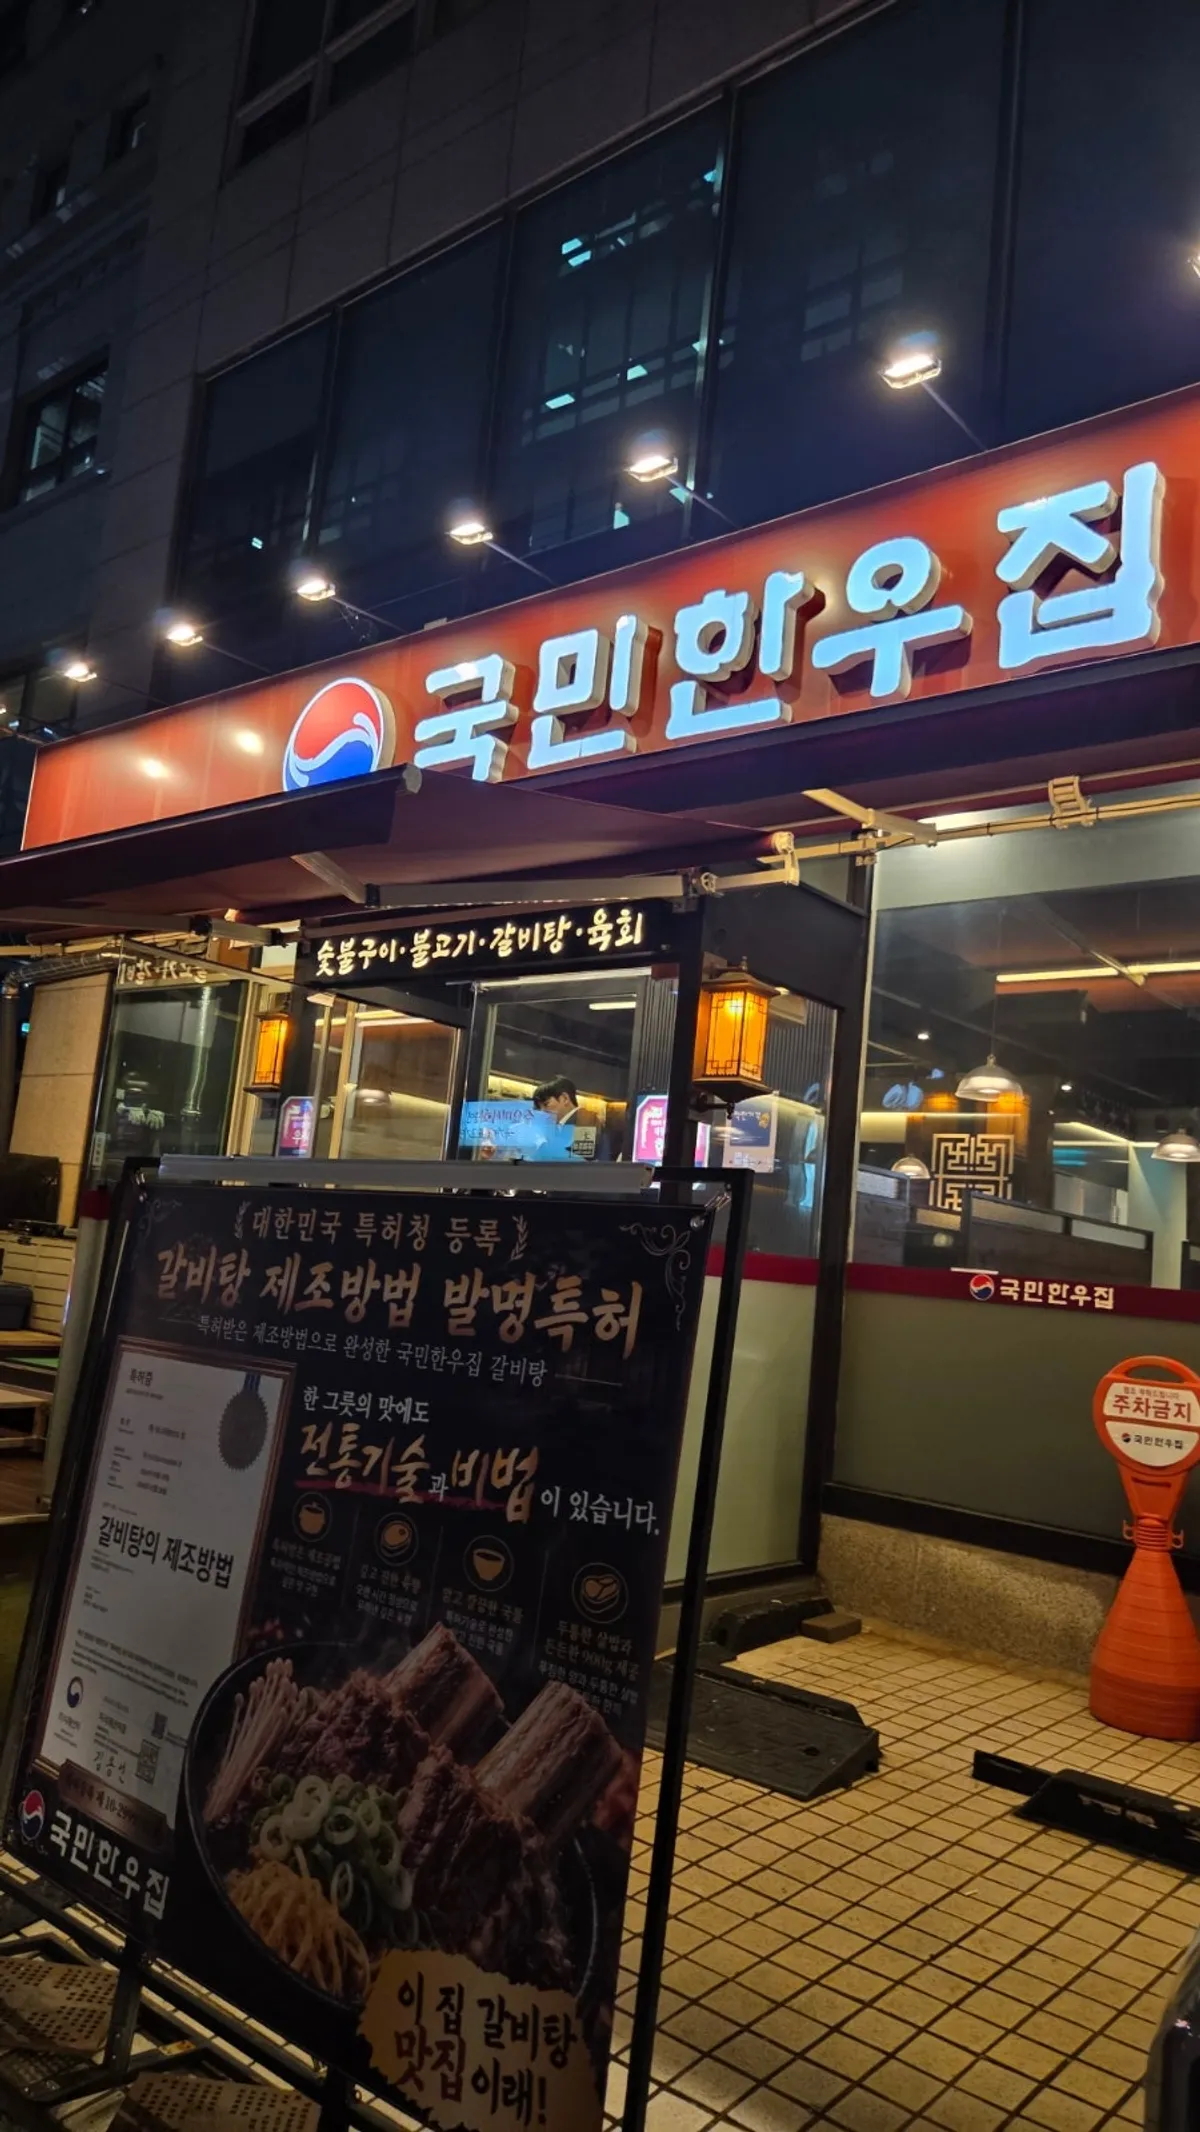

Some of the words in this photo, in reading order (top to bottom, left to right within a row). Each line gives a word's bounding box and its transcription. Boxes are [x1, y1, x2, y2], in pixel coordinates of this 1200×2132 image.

[413, 461, 1166, 783] 국민한우집
[252, 1206, 342, 1244] 대한민국
[354, 1212, 430, 1251] 특허청
[444, 1217, 502, 1256] 등록
[158, 1243, 251, 1307] 갈비탕
[259, 1252, 422, 1329] 제조방법
[444, 1267, 643, 1361] 발명특허
[1000, 1278, 1115, 1310] 국민한우집
[197, 1315, 249, 1342] 특허받은
[252, 1322, 338, 1353] 제조방법으로
[343, 1334, 392, 1364] 완성한
[396, 1341, 483, 1378] 국민한우집
[489, 1354, 548, 1388] 갈비탕
[303, 1387, 319, 1412] 한
[323, 1391, 372, 1420] 그릇의
[378, 1396, 431, 1424] 맛에도
[1112, 1394, 1192, 1423] 주차금지
[568, 1489, 660, 1536] 있습니다.
[98, 1515, 160, 1565] 갈비탕의
[162, 1536, 235, 1589] 제조방법
[49, 1808, 170, 1921] 국민한우집
[397, 1971, 424, 2026] 이
[435, 1983, 465, 2037] 집
[476, 1993, 578, 2069] 갈비탕
[394, 2023, 548, 2126] 맛집이래!
